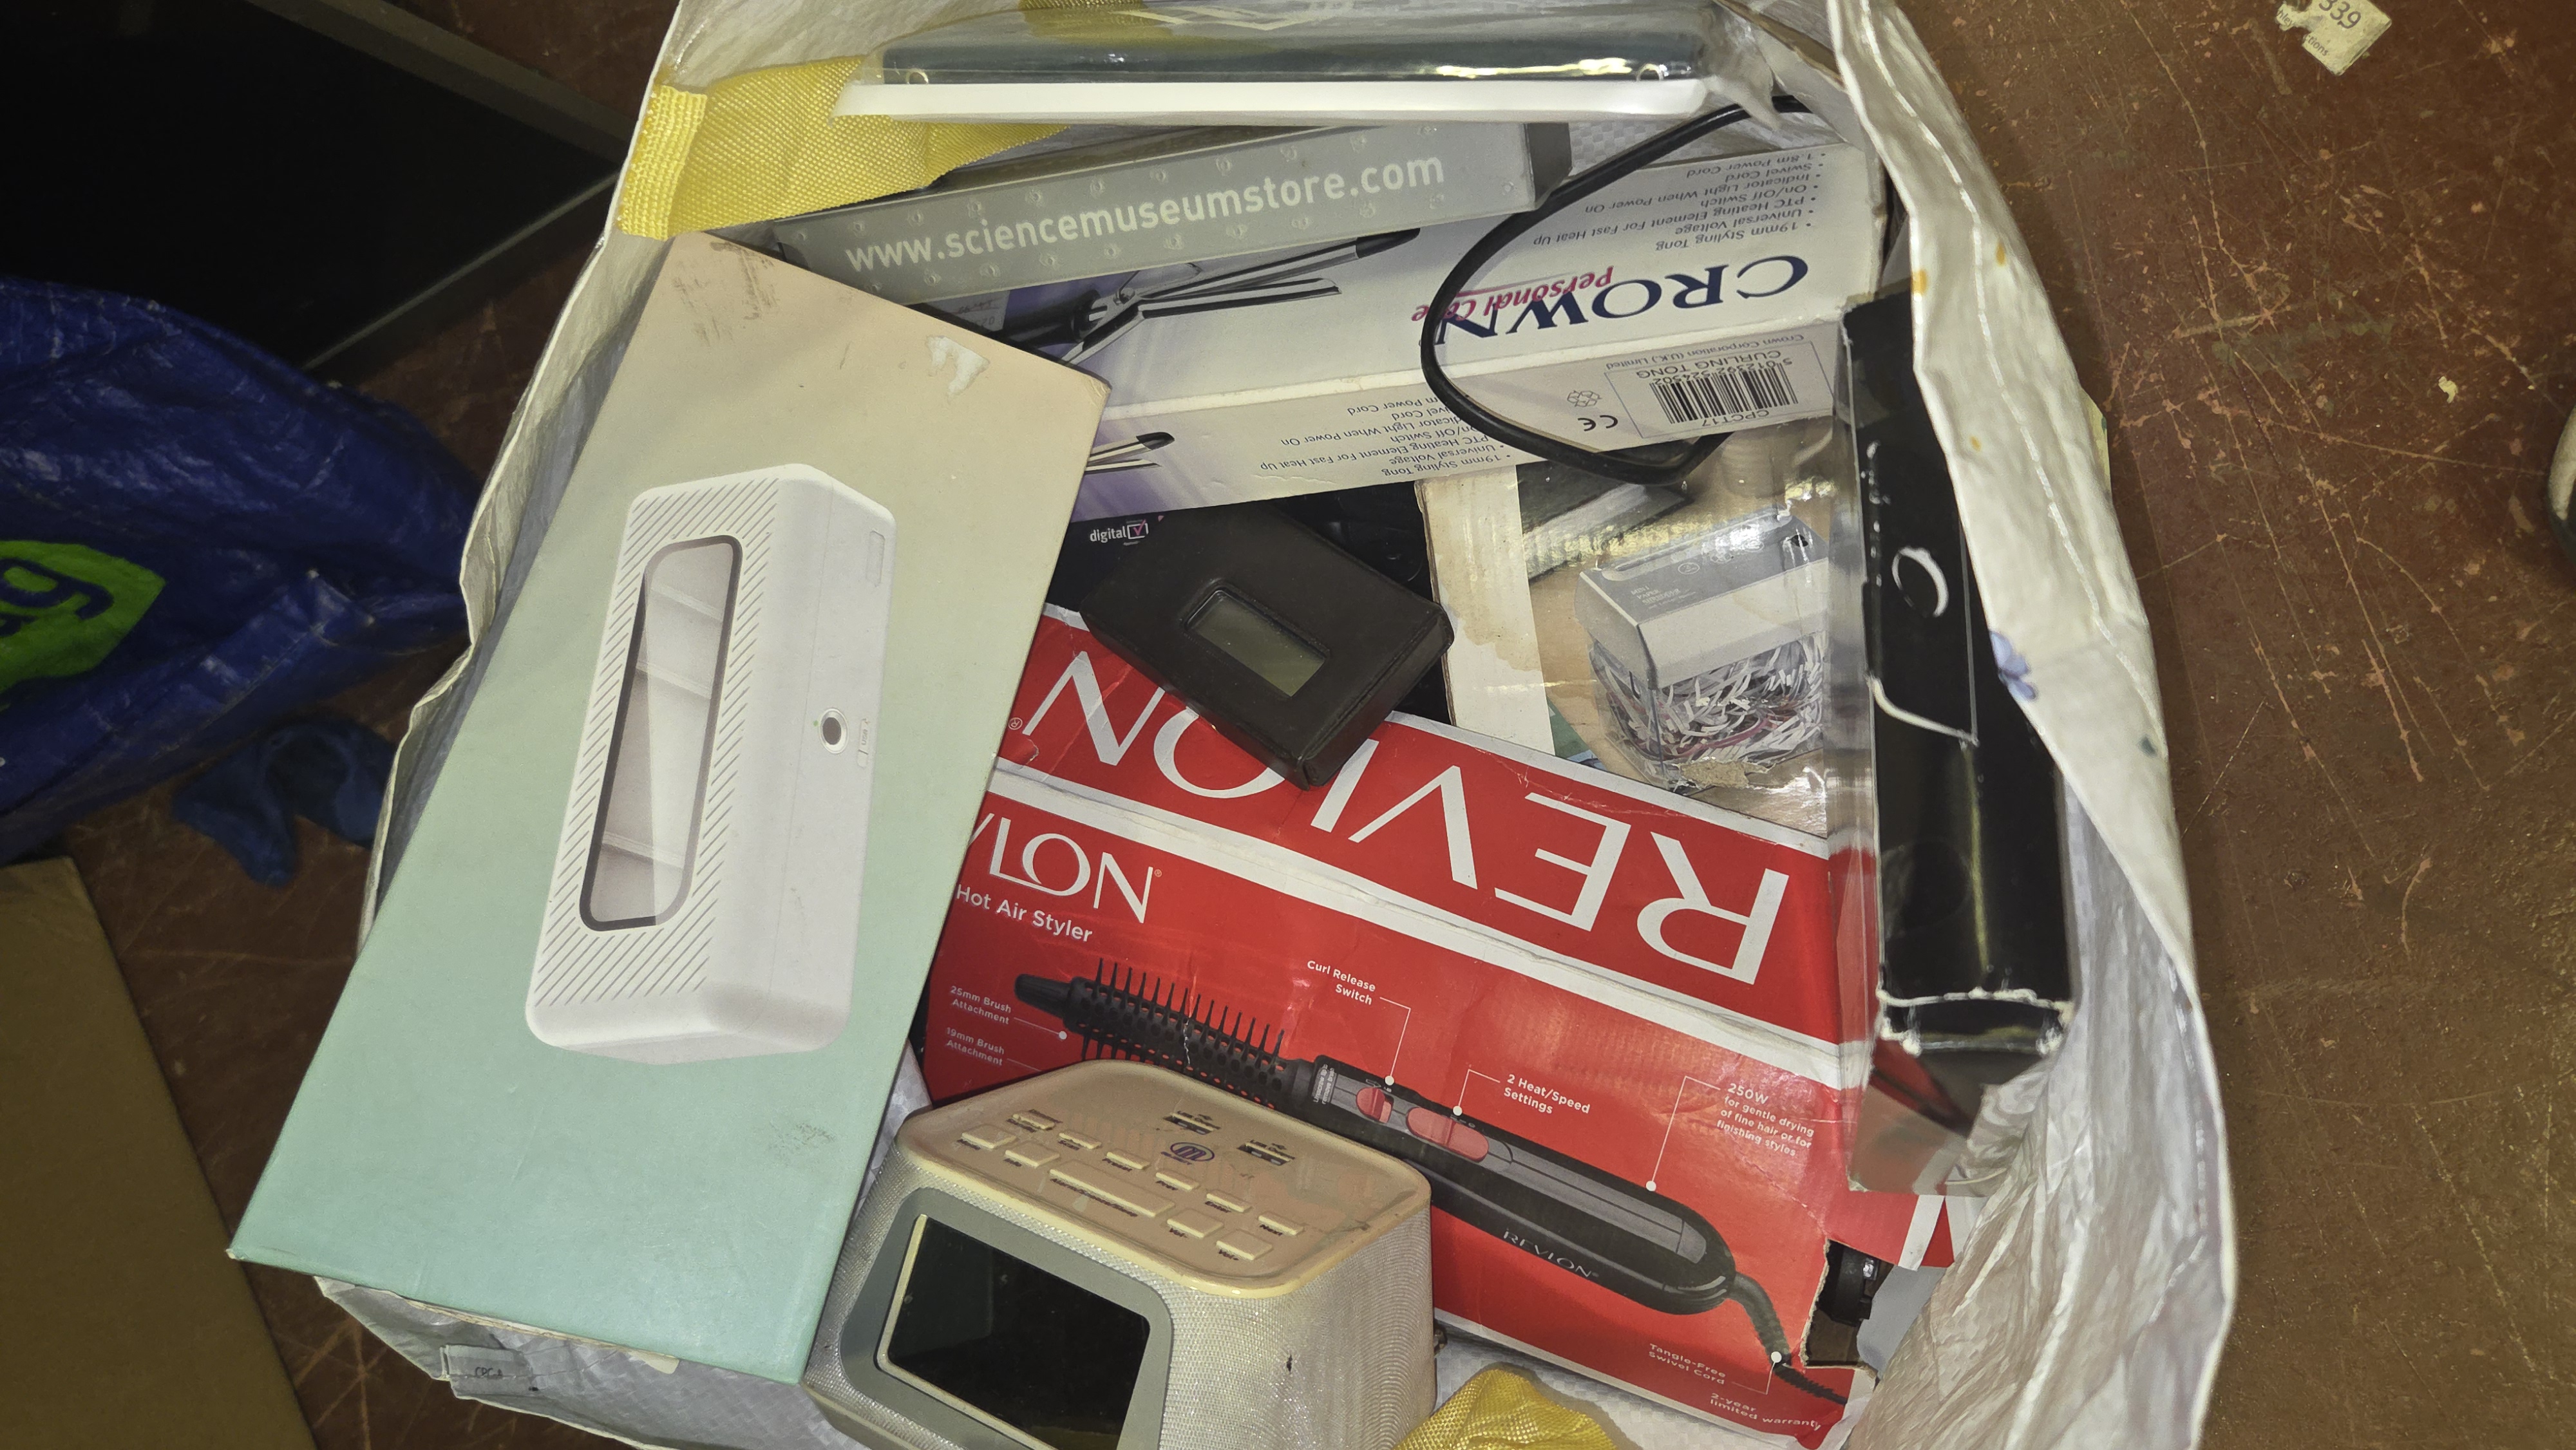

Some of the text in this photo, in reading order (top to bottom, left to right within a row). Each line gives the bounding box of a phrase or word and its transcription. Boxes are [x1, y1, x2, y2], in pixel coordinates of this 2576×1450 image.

[1725, 163, 1813, 183] Swivel Cord
[1585, 173, 1810, 213] Indicator Light When Power On
[1701, 184, 1807, 208] On/Off Switch
[846, 156, 1444, 272] www.sciencemuseumstore.com
[1533, 196, 1804, 245] PTC Heating Element For Fast Heat Up
[1675, 209, 1802, 235] Universal Voltage
[1656, 222, 1799, 250] 19mm Styling Tong
[1411, 265, 1614, 322] Personal Cae
[1418, 255, 1808, 346] CROWN
[1687, 341, 1759, 357] Corporation
[1763, 334, 1804, 344] Crown
[1606, 357, 1649, 370] Limited
[1636, 350, 1781, 379] CURLING TONG
[1347, 405, 1379, 416] Cord
[1383, 399, 1423, 410] Power
[1392, 406, 1450, 421] ivel Cord
[1385, 422, 1415, 433] Light
[1419, 415, 1461, 428] dicator
[1702, 410, 1770, 427] CPCT17
[1304, 433, 1341, 443] Power
[1343, 428, 1381, 438] When
[1390, 431, 1432, 443] Switch
[1260, 435, 1489, 471] PTC Heating Element For Fast Heat Up
[1381, 455, 1502, 476] 19mm Styling Tong
[1389, 444, 1496, 465] Universal Voltage
[1090, 525, 1126, 543] digital
[956, 883, 1094, 942] Hot Air Styler
[1307, 960, 1376, 992] Curl Release
[950, 985, 1012, 1013] 25mm Brush
[1335, 984, 1372, 1005] Switch
[952, 999, 1010, 1025] Attachment
[946, 1027, 1005, 1055] 19mm Brush
[946, 1040, 1003, 1066] Attachment
[1504, 1087, 1553, 1114] Settings
[1507, 1074, 1591, 1114] 2 Heat/Speed
[1727, 1083, 1769, 1104] 250W
[1720, 1109, 1812, 1149] of fine hair or for
[1724, 1096, 1815, 1138] for gentle drying
[1717, 1120, 1796, 1157] finishing styles
[1649, 1343, 1727, 1378] Tangle-Free
[1649, 1351, 1725, 1385] Swivel Cord
[1710, 1393, 1757, 1412] 2-year
[1710, 1399, 1821, 1431] limited warranty
